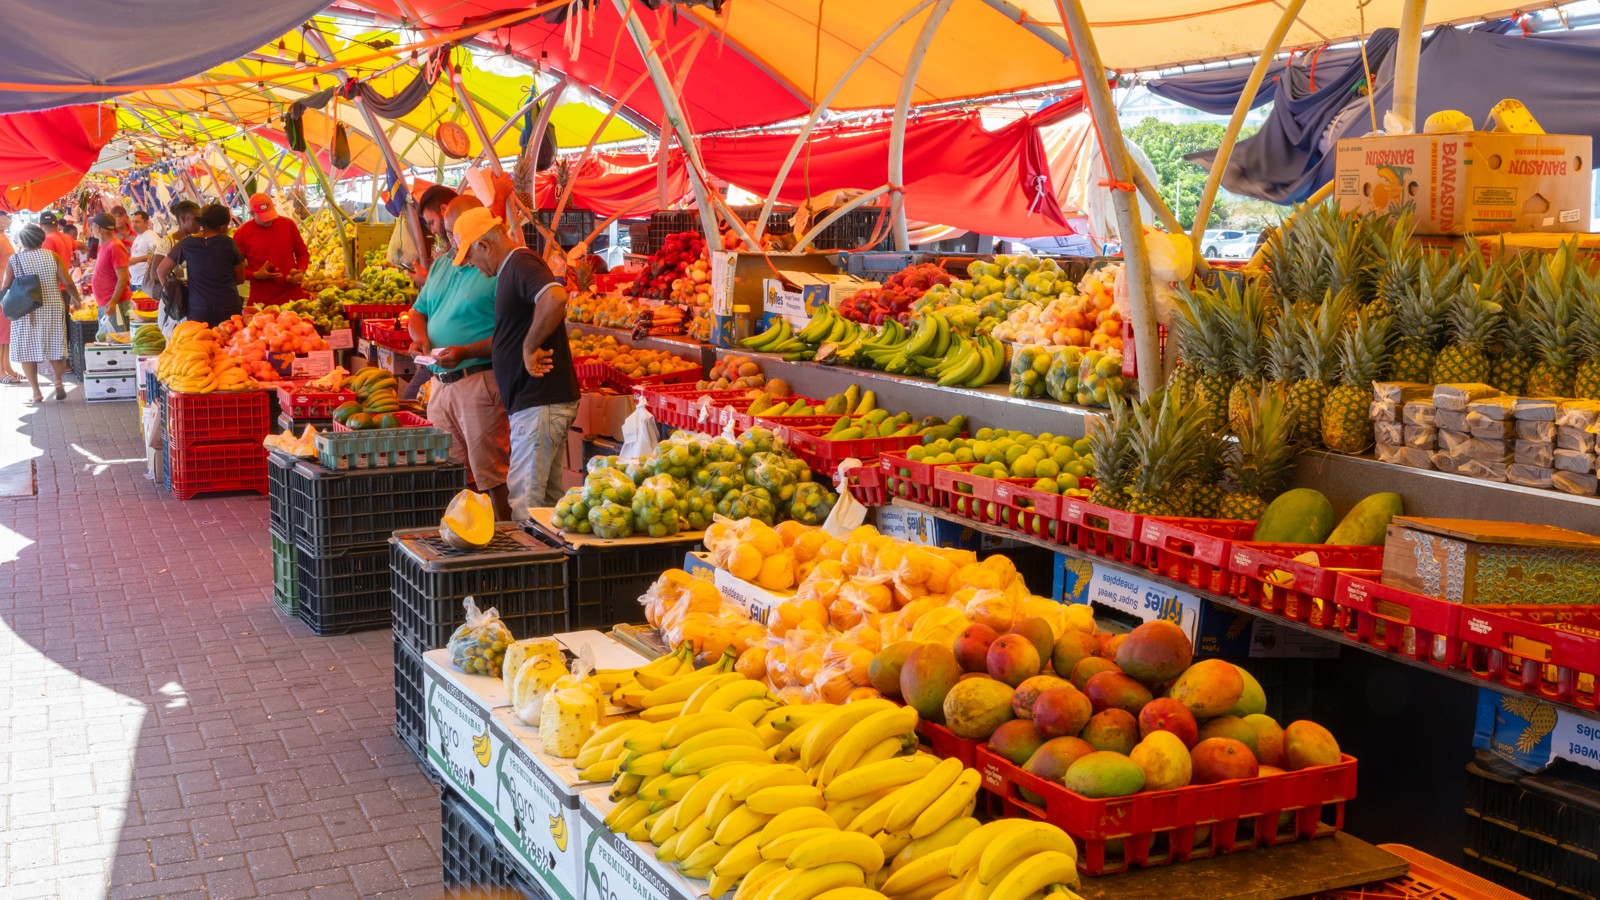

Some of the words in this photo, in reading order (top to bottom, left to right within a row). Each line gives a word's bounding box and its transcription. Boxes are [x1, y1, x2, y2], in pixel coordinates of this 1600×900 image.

[1365, 149, 1415, 166] BANASUN
[1508, 160, 1567, 176] BANASUN
[1440, 142, 1457, 232] BANASUN
[721, 584, 747, 607] Pineapples
[1098, 587, 1117, 602] Sweet
[1102, 573, 1139, 595] Pineapples
[1117, 594, 1138, 610] Super
[1144, 591, 1183, 626] Fyffes
[446, 682, 460, 698] CLASS
[437, 691, 458, 714] PREMIUM
[458, 708, 481, 733] BANANAS
[437, 708, 459, 748] Agro
[509, 756, 532, 786] PREMIUM
[532, 782, 556, 813] BANANAS
[518, 749, 532, 767] CLASS
[534, 765, 555, 793] Bananas
[509, 775, 535, 824] Agro
[598, 844, 631, 884] PREMIUM
[613, 837, 633, 865] CLASS
[639, 861, 670, 898] Bananas
